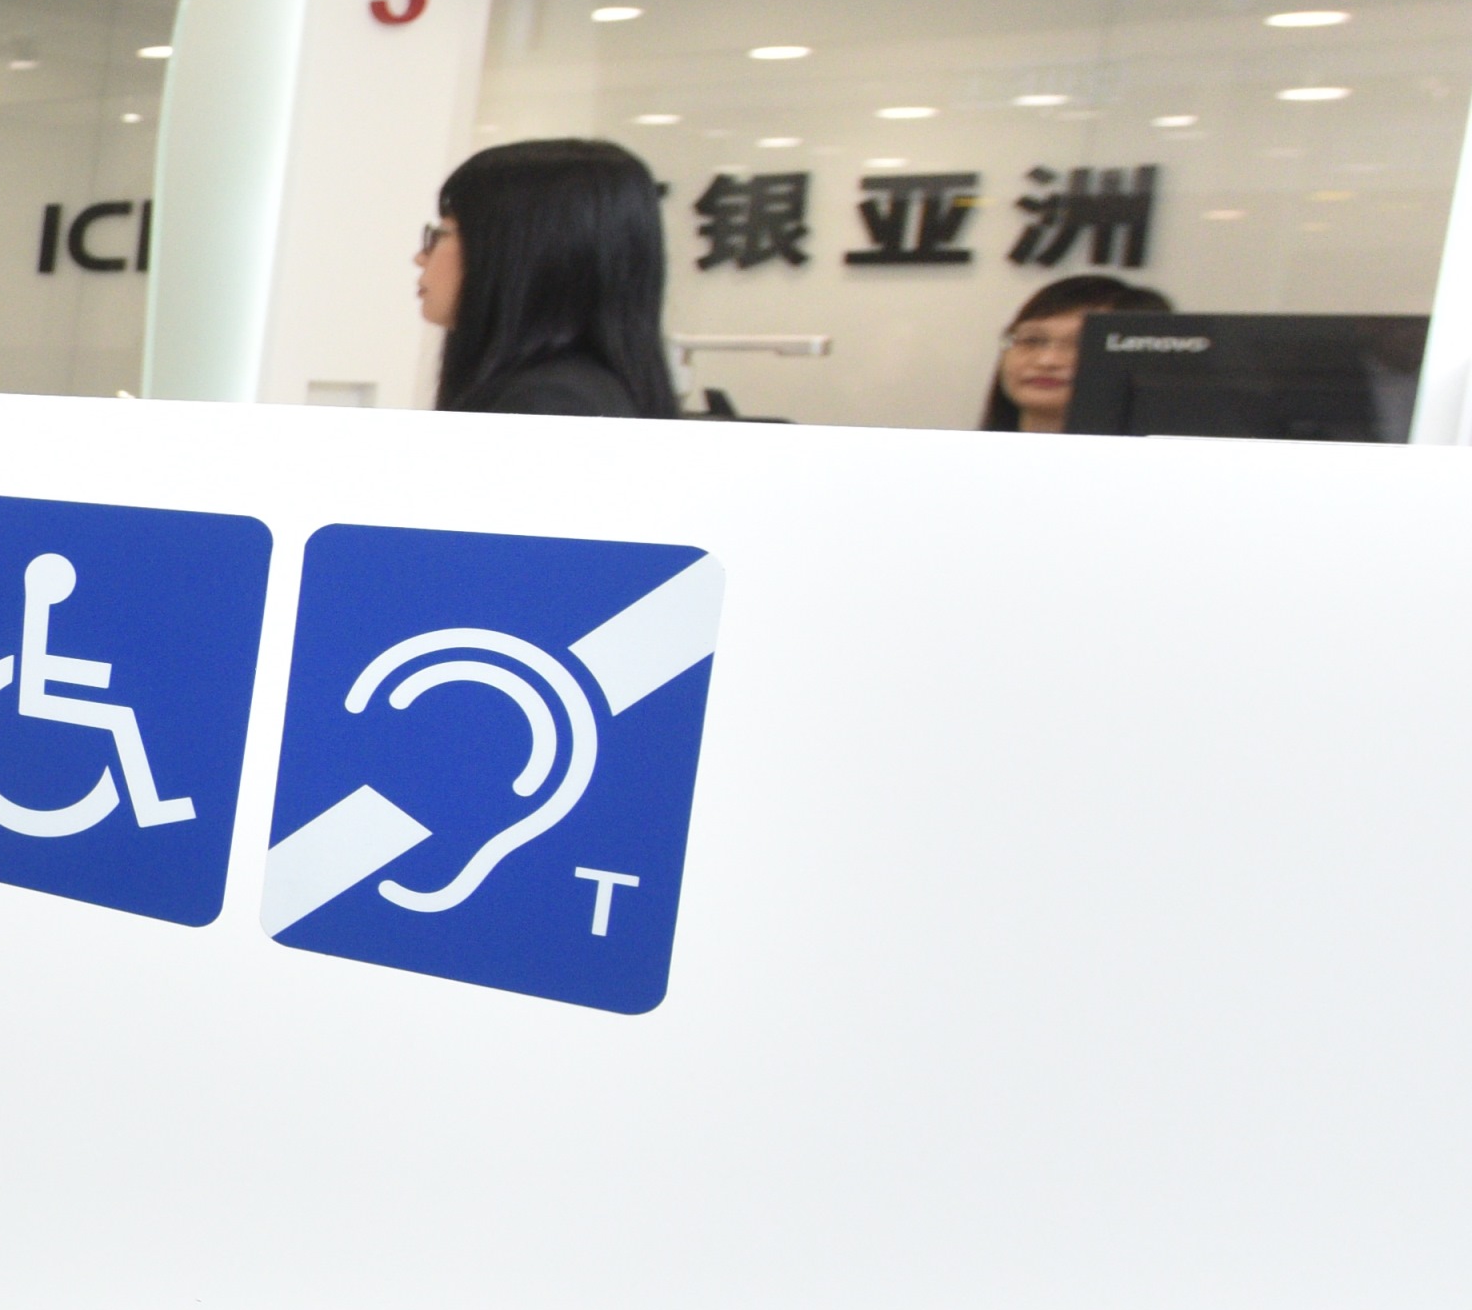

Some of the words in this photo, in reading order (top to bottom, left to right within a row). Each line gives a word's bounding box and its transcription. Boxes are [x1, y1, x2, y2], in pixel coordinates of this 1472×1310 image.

[655, 162, 1160, 270] 银亚洲
[1105, 331, 1211, 353] Lenovo
[574, 866, 640, 937] T
